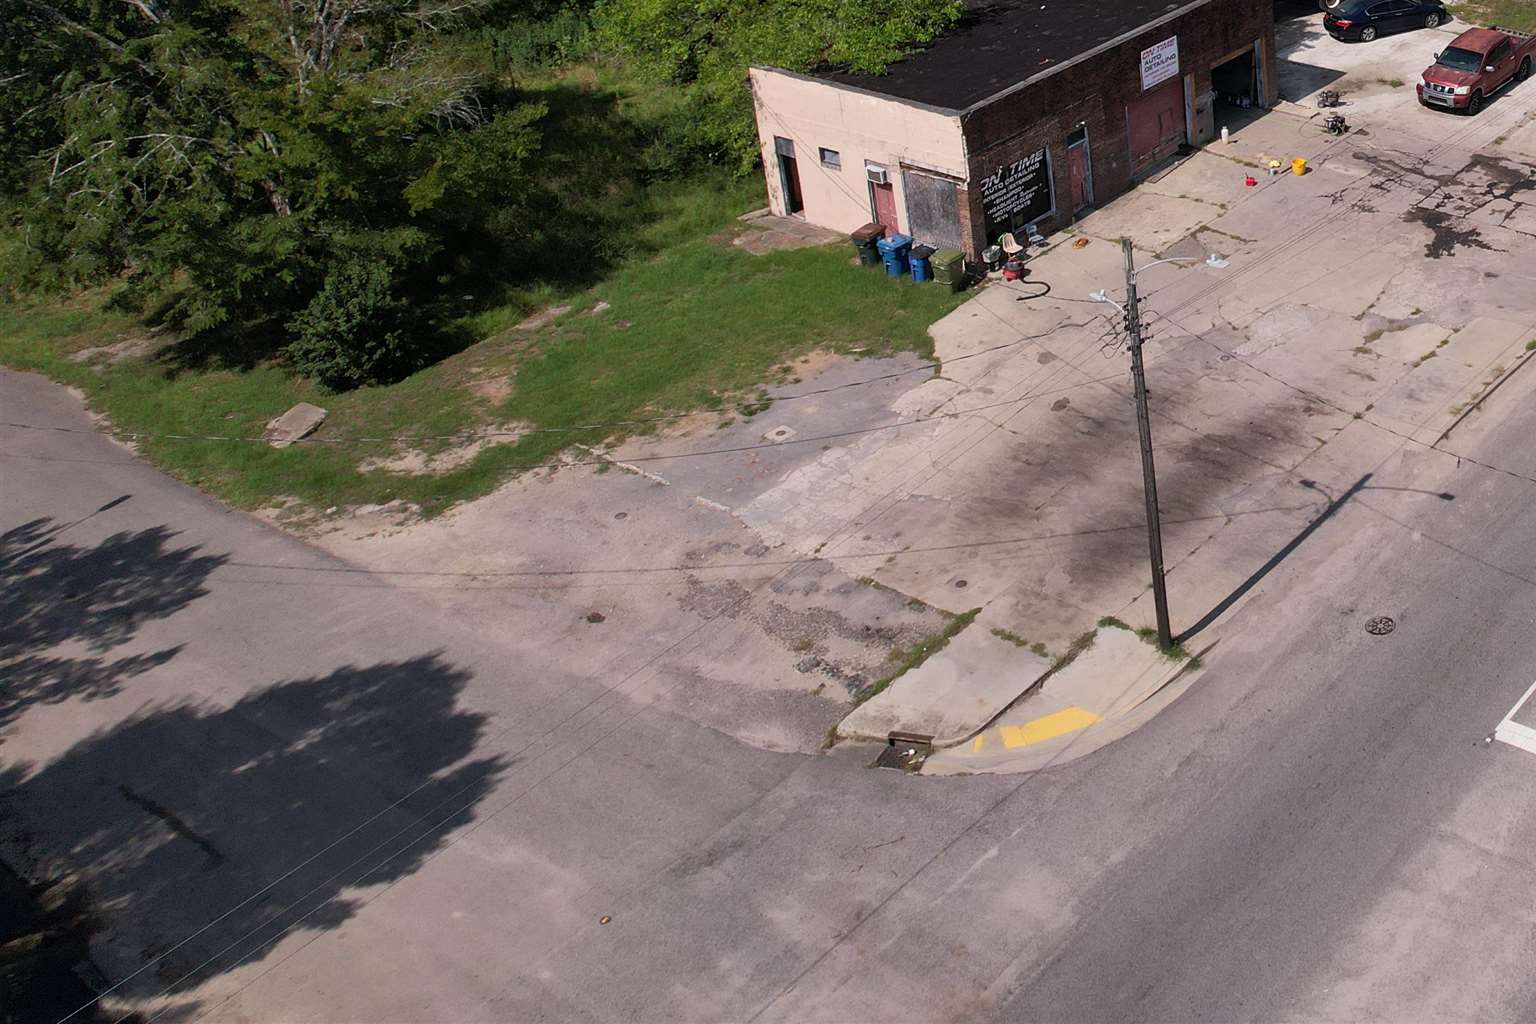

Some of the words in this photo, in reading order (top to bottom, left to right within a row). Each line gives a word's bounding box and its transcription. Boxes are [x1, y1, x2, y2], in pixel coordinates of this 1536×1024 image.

[1145, 54, 1162, 66] AUTO
[1145, 53, 1177, 73] DETAILING
[980, 167, 1002, 192] ON
[1009, 148, 1045, 175] TIME
[984, 182, 1004, 197] AUTO
[1004, 162, 1040, 185] DETAILING
[983, 188, 1007, 204] INTERIOR
[1013, 200, 1031, 213] BOATS
